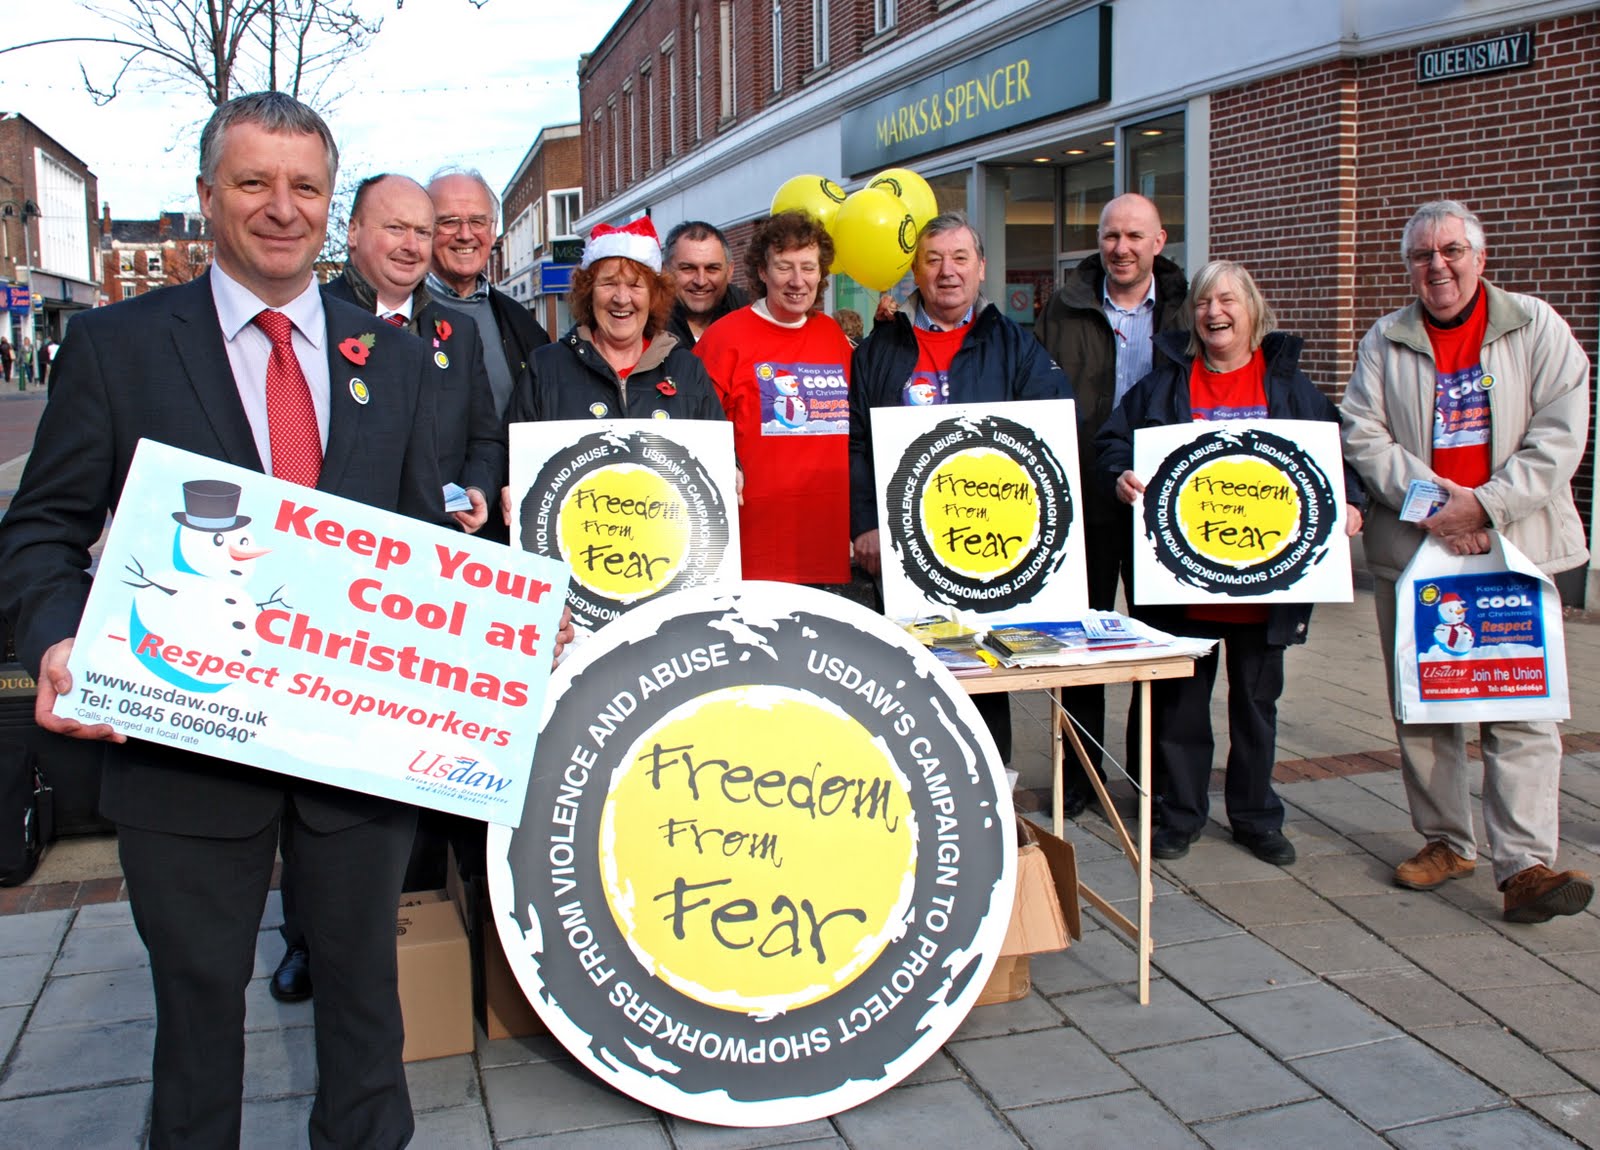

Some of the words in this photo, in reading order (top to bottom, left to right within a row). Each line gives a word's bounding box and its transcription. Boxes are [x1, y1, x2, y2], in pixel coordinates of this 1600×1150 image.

[1424, 37, 1521, 77] QUEENSWAY
[876, 98, 929, 151] MARKS
[930, 93, 942, 131] &
[945, 59, 1031, 127] SPENCER
[798, 367, 821, 375] Keep
[1213, 410, 1240, 418] Keep
[570, 445, 610, 472] ABUSE
[929, 431, 964, 457] ABUSE
[993, 431, 1037, 466] USDAW'S
[1189, 441, 1224, 463] ABUSE
[1253, 441, 1298, 472] USDAW'S
[550, 468, 571, 492] AND
[642, 447, 690, 485] USDAW'S
[912, 453, 931, 477] AND
[1171, 460, 1189, 479] AND
[932, 473, 1032, 505] Freedom
[1034, 465, 1058, 526] CAMPAIGN
[1157, 478, 1175, 529] VIOLENCE
[1190, 476, 1293, 505] Freedom
[1297, 471, 1320, 524] CAMPAIGN
[536, 491, 556, 554] VIOLENCE
[902, 476, 918, 537] VIOLENCE
[942, 503, 989, 521] From
[1198, 500, 1247, 517] From
[581, 520, 634, 541] From
[942, 526, 1022, 559] Fear
[1044, 530, 1055, 545] TO
[1162, 530, 1182, 558] FROM
[1197, 520, 1281, 550] Fear
[1303, 525, 1319, 541] TO
[274, 499, 411, 570] Keep
[435, 543, 551, 604] Your
[580, 544, 670, 581] Fear
[908, 540, 933, 571] FROM
[1014, 546, 1050, 590] PROTECT
[1270, 541, 1311, 578] PROTECT
[929, 569, 1011, 599] SHOPWORKERS
[1181, 556, 1267, 584] SHOPWORKERS
[565, 587, 621, 621] WORKERS
[1476, 594, 1532, 609] COOL
[1507, 583, 1531, 592] your
[348, 577, 468, 636] Cool
[485, 621, 541, 656] at
[1481, 620, 1533, 634] Respect
[1488, 609, 1533, 618] Christmas
[255, 609, 529, 707] Christmas
[638, 643, 729, 700] ABUSE
[1423, 665, 1468, 679] Usdaw
[1471, 669, 1492, 682] Join
[1493, 668, 1510, 680] the
[1513, 667, 1543, 680] Union
[80, 688, 112, 710] Tel:
[118, 699, 165, 722] 0845
[86, 670, 269, 726] www.usdaw.org.uk
[136, 633, 280, 688] Respect
[287, 673, 511, 748] Shopworkers
[807, 650, 916, 736] USDAW'S
[104, 716, 142, 732] charged
[145, 725, 154, 734] at
[157, 729, 179, 740] local
[181, 735, 199, 745] rate
[588, 691, 637, 748] AND
[408, 749, 512, 792] Usdaw
[638, 743, 899, 833] Freedom
[550, 745, 598, 897] VIOLENCE
[909, 737, 961, 887] CAMPAIGN
[658, 818, 783, 868] From
[653, 877, 867, 964] Fear
[926, 896, 955, 933] TO
[557, 900, 616, 987] FROM
[837, 934, 938, 1044] PROTECT
[608, 981, 831, 1064] SHOPWORKERS
